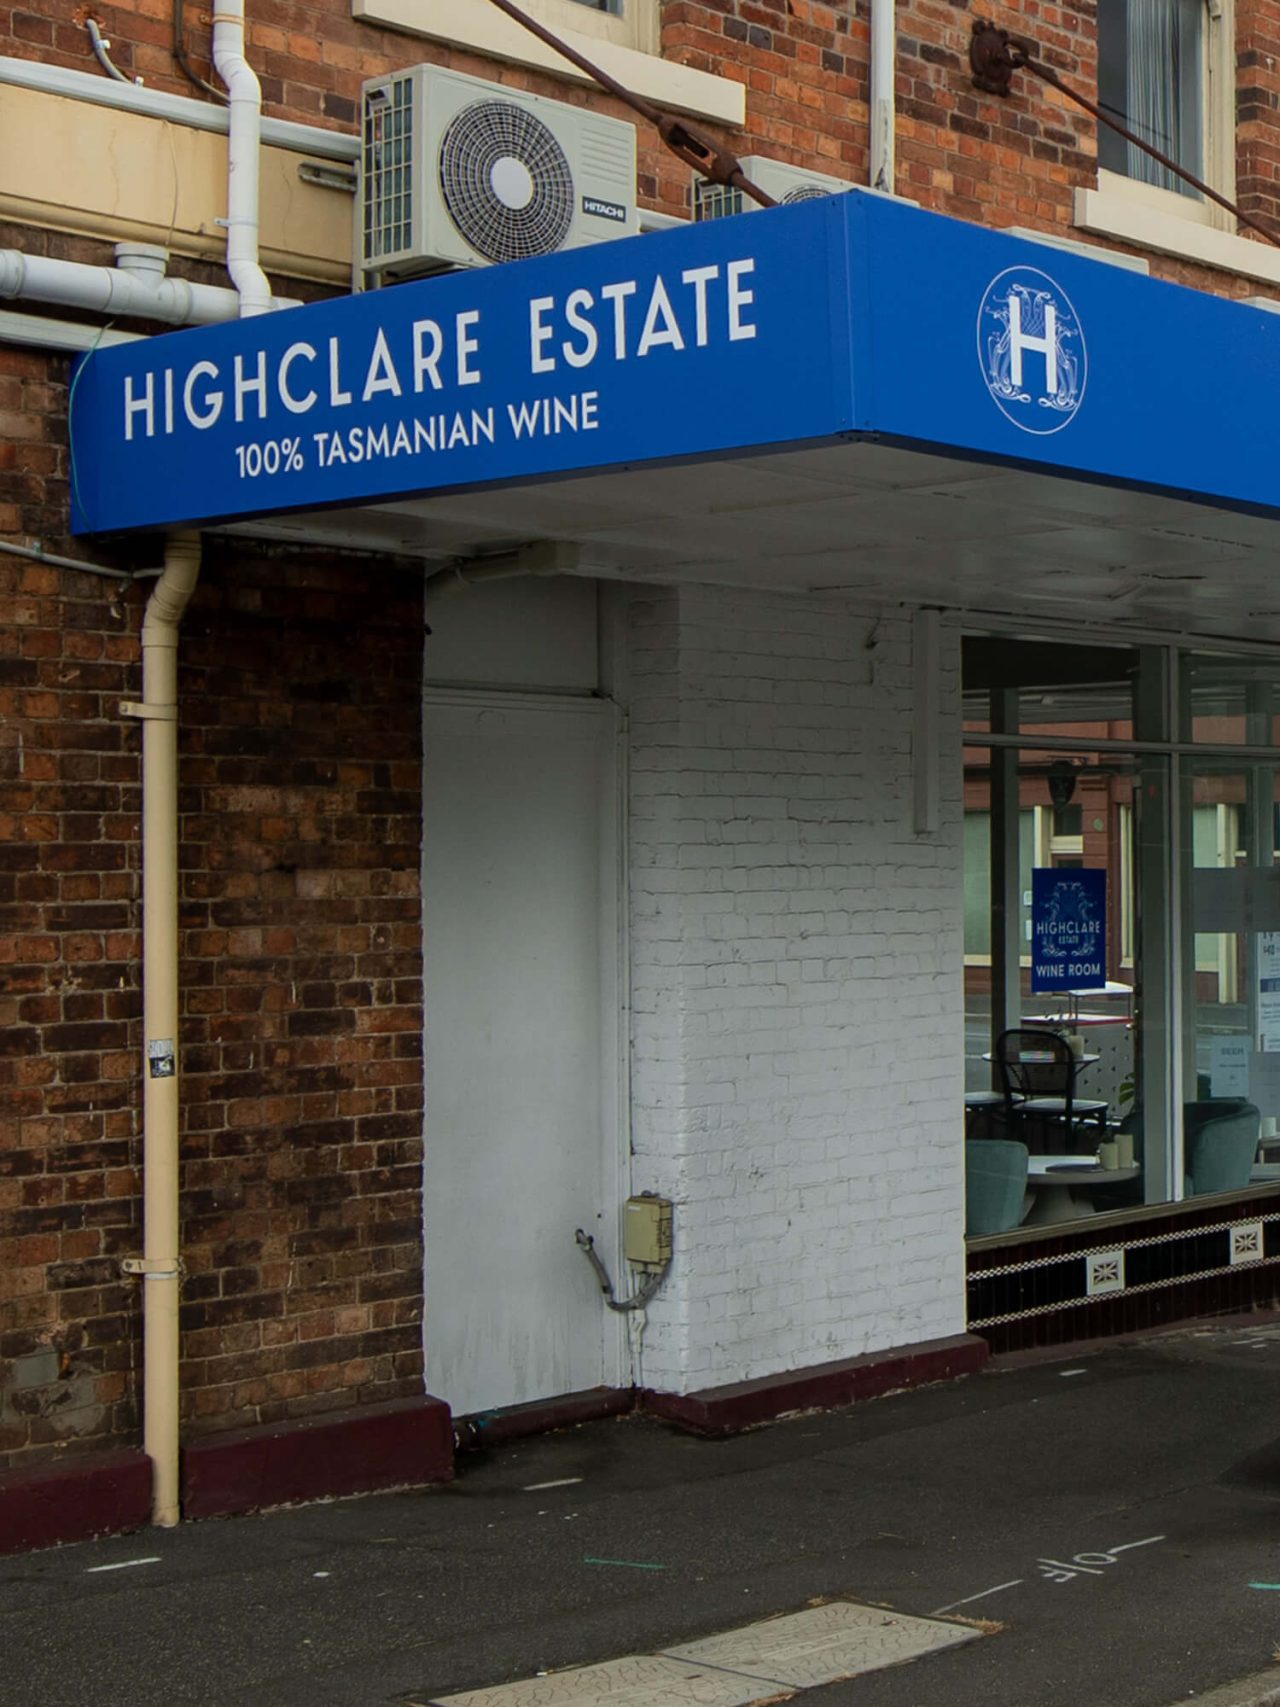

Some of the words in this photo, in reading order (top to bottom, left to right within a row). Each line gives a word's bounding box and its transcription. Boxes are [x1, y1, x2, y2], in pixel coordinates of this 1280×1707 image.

[584, 200, 624, 218] HITACHI
[125, 310, 480, 440] HIGHCLARE
[530, 258, 757, 374] ESTATE
[236, 442, 303, 477] 100%
[313, 407, 495, 467] TASMANIAN
[507, 391, 599, 439] WINE
[1036, 921, 1101, 935] HIGHCLARE
[1058, 935, 1079, 945] ESTATE
[1036, 964, 1065, 978] WINE
[1068, 962, 1101, 977] ROOM
